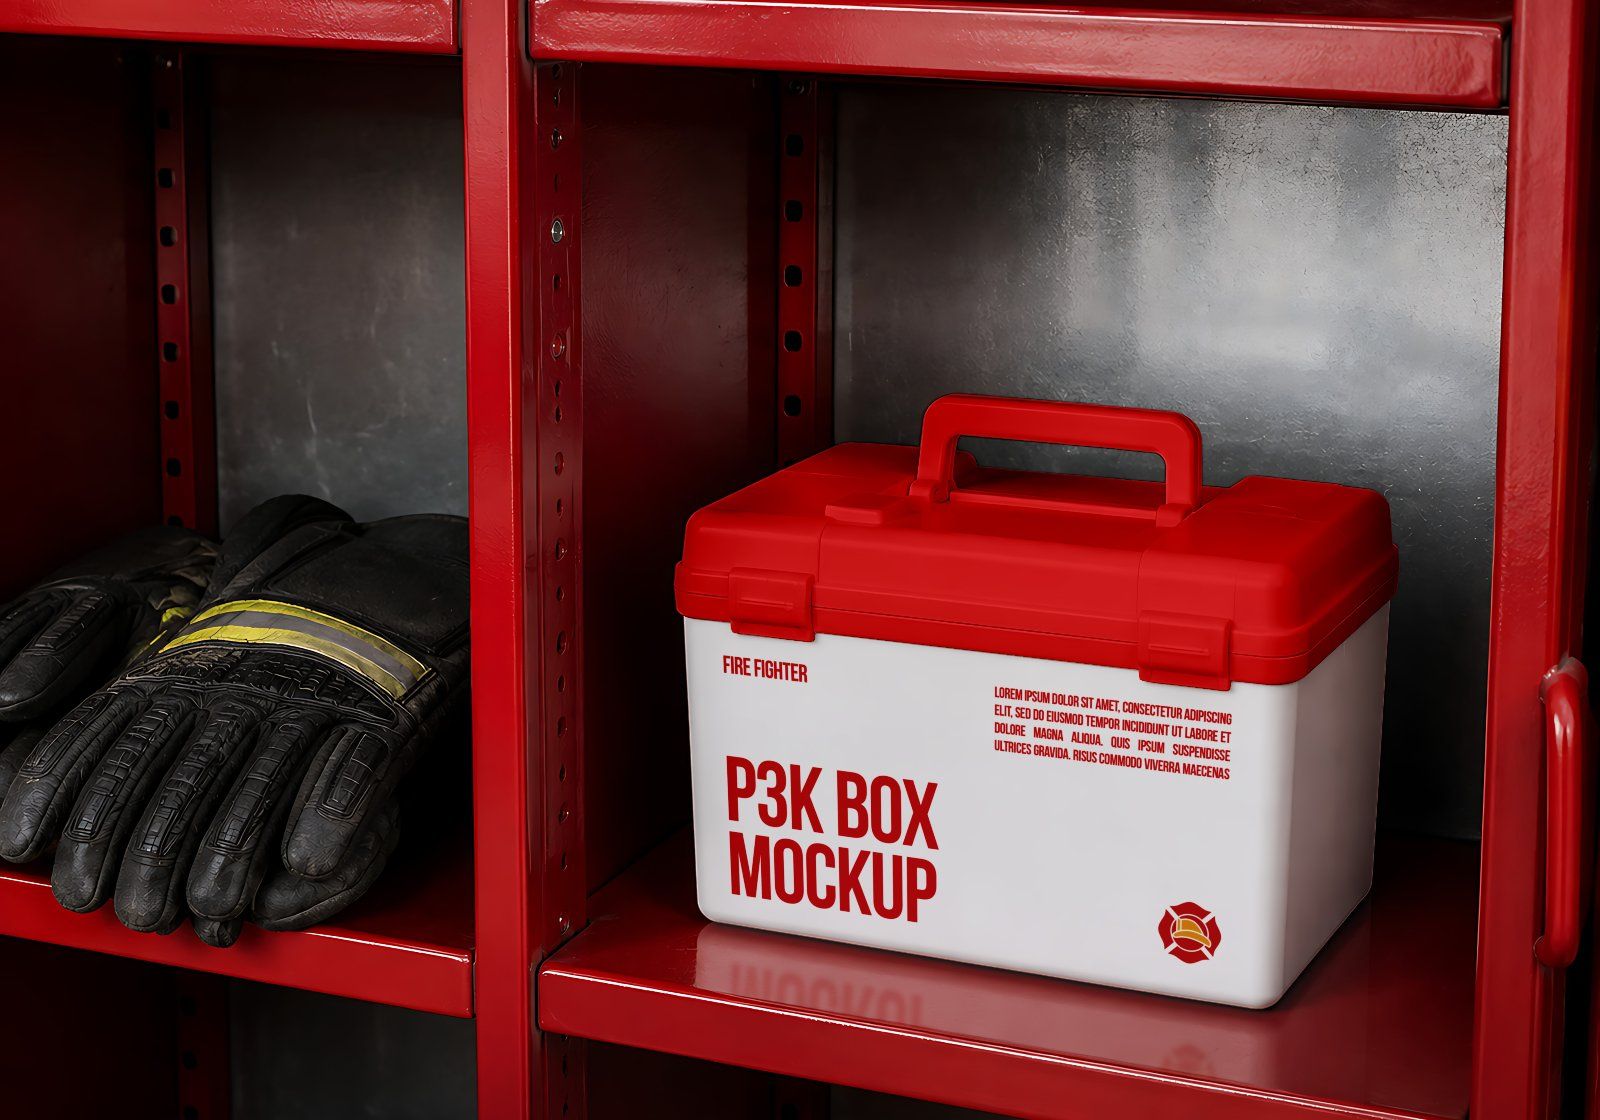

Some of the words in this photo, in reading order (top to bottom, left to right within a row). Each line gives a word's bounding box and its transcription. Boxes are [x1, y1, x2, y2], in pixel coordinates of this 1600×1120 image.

[723, 655, 751, 677] FIRE
[754, 658, 808, 683] FIGHTER
[994, 687, 1024, 700] LOREM
[1024, 690, 1051, 704] IPSUM
[1051, 693, 1080, 707] DOLOR
[1081, 696, 1094, 709] SIT
[1096, 698, 1120, 713] AMET,
[1123, 701, 1183, 719] CONSECTETUR
[1183, 708, 1232, 725] ADIPISCING
[994, 704, 1013, 717] ELIT,
[1015, 707, 1032, 719] SED
[1032, 709, 1046, 720] DO
[1046, 711, 1083, 726] EIUSMOD
[1085, 714, 1121, 730] TEMPOR
[1121, 719, 1169, 735] INCIDIDUNT
[1172, 725, 1184, 737] UT
[1184, 728, 1220, 742] LABORE
[1220, 731, 1231, 743] ET
[994, 722, 1026, 737] DOLORE
[1033, 727, 1063, 741] MAGNA
[1072, 731, 1103, 746] ALIQUA.
[1111, 736, 1131, 749] QUIS
[1138, 740, 1165, 754] IPSUM
[1173, 743, 1230, 762] SUSPENDISSE
[994, 740, 1033, 755] ULTRICES
[1033, 744, 1071, 760] GRAVIDA.
[1073, 749, 1099, 763] RISUS
[1099, 752, 1143, 768] COMMODO
[1144, 758, 1182, 773] VIVERRA
[1182, 763, 1230, 780] MAECENAS
[726, 755, 824, 834] P3K
[836, 770, 940, 850] BOX
[729, 831, 938, 923] MOCKUP
